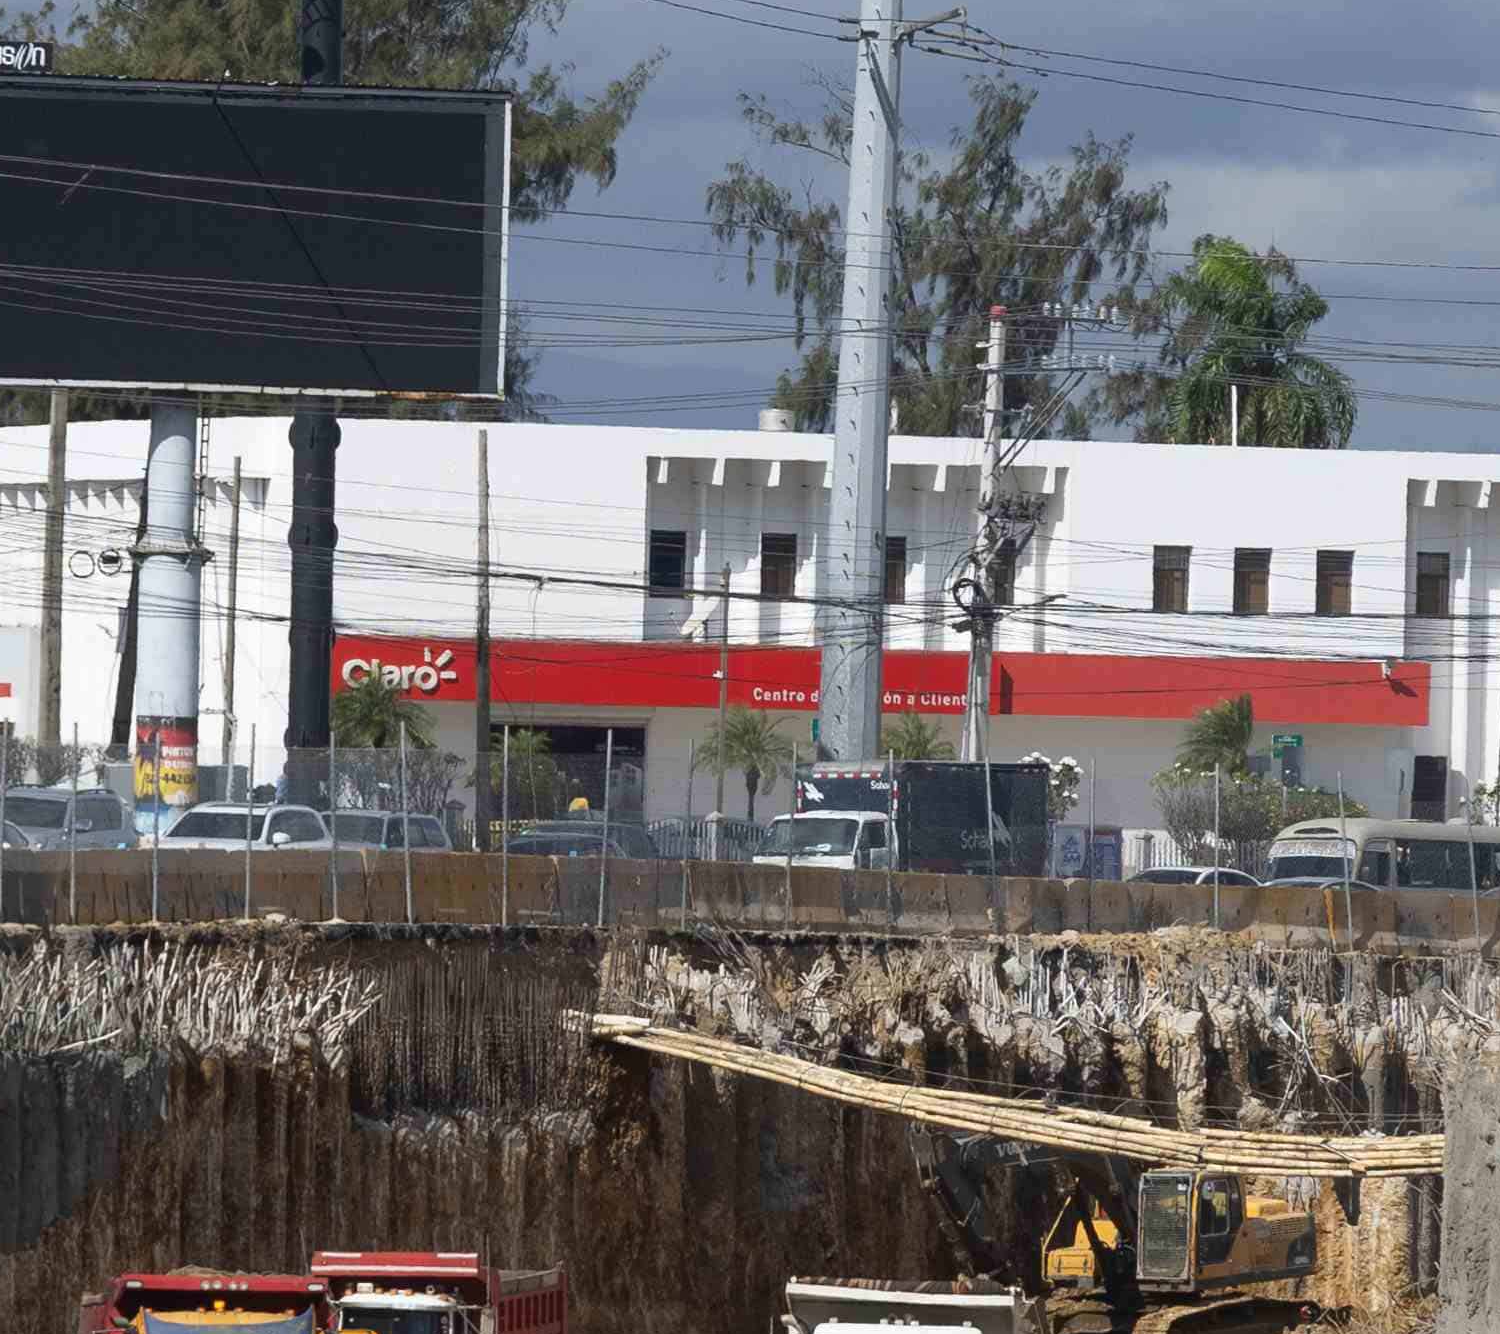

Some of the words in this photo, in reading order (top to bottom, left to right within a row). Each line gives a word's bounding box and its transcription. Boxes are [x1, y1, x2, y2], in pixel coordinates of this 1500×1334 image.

[342, 656, 439, 691] Claro
[753, 687, 805, 702] Centro
[921, 694, 970, 707] Client
